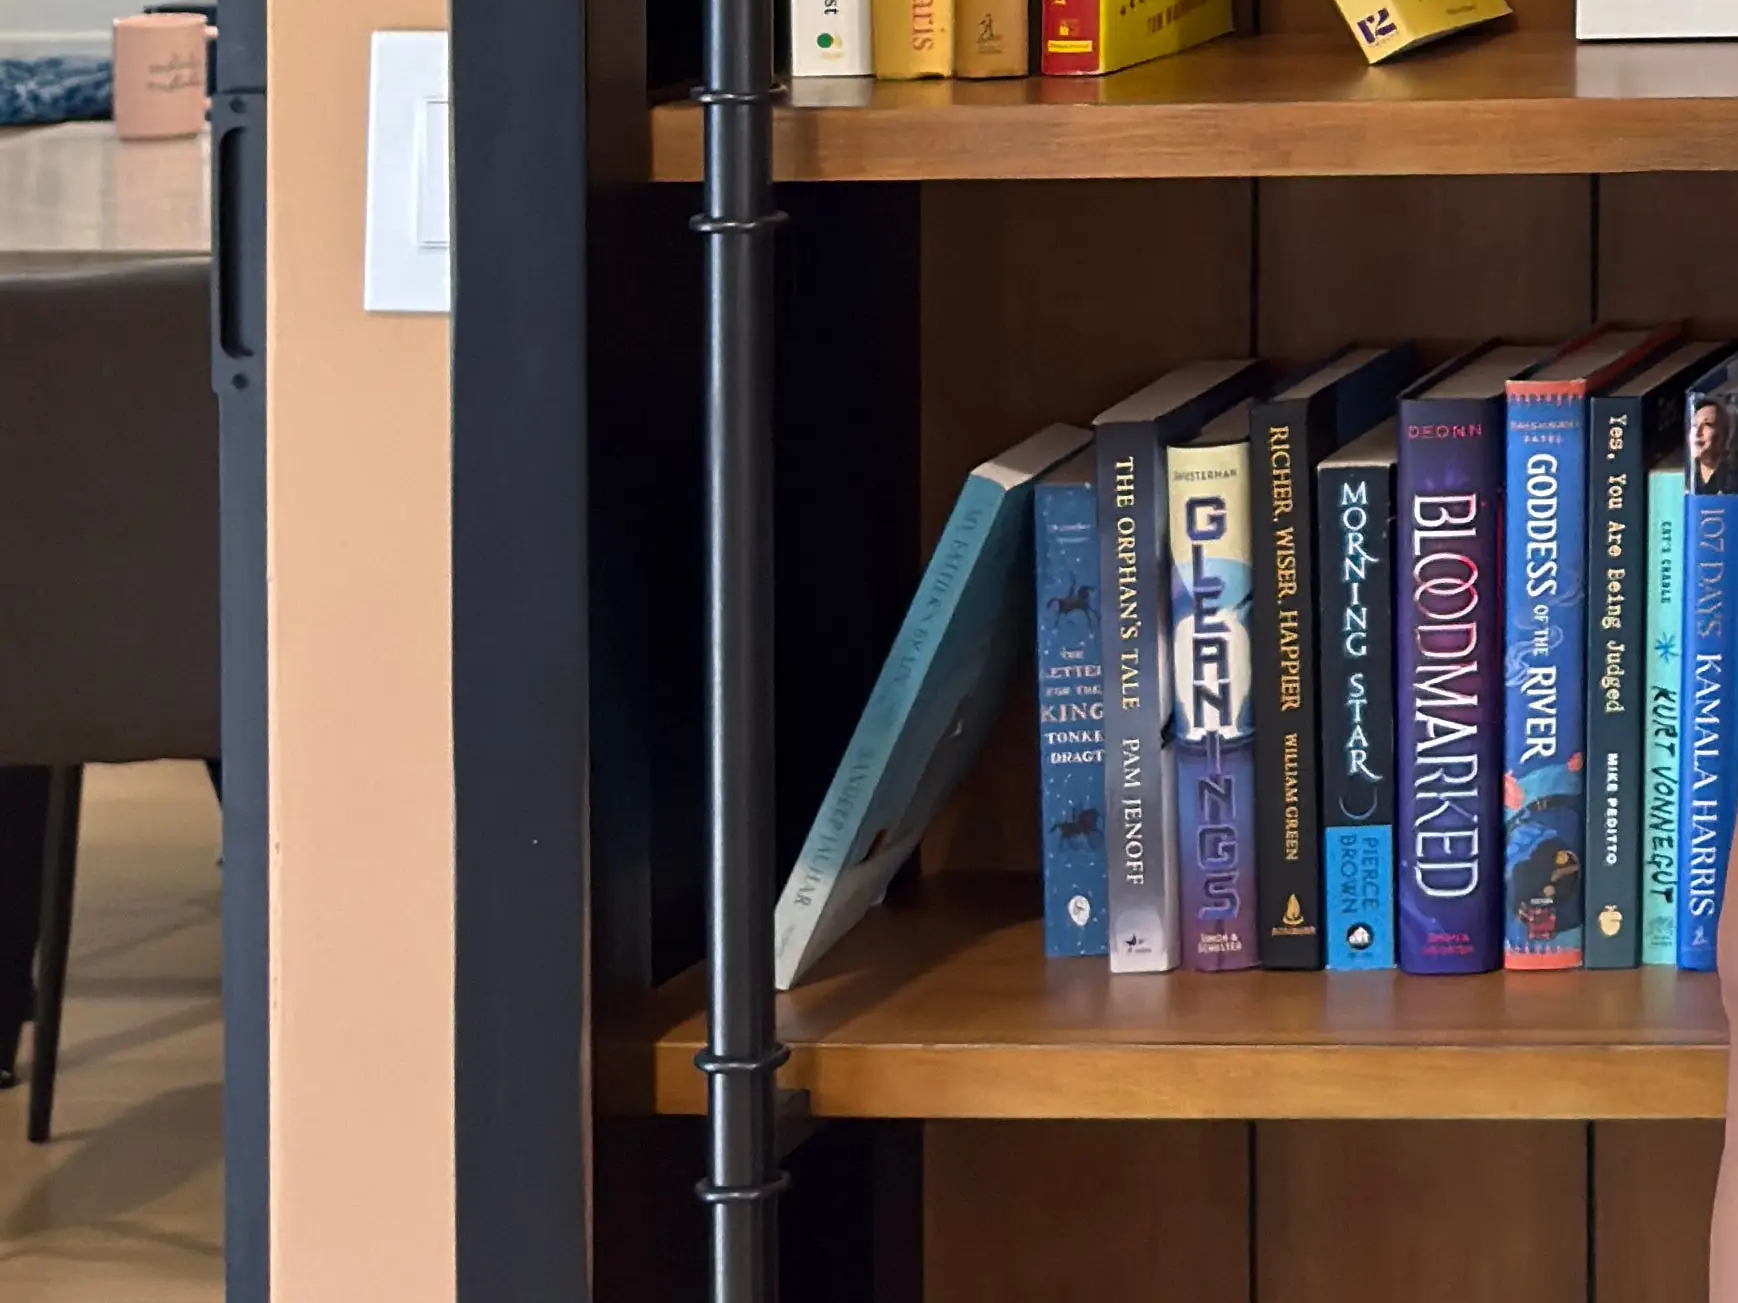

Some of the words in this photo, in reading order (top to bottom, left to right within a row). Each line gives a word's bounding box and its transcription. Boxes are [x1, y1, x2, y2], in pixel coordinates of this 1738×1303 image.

[1408, 424, 1482, 440] DEONN
[1114, 456, 1135, 508] THE
[1526, 453, 1558, 598] GODDESS
[1700, 508, 1726, 554] 107
[1116, 516, 1142, 640] ORPHAN'S
[1339, 480, 1380, 657] MORNING
[1696, 562, 1725, 639] DAYS
[1532, 604, 1549, 624] OF
[1532, 624, 1549, 657] THE
[1120, 648, 1140, 710] TALE
[1186, 496, 1240, 920] GLEANINGS
[1412, 493, 1479, 898] BLOODMARKED
[1520, 666, 1558, 764] RIVER
[1121, 738, 1140, 788] PAM
[1346, 672, 1384, 780] STAR
[1692, 653, 1723, 791] KAMALA
[1120, 798, 1144, 885] JENOFF
[1340, 835, 1358, 914] BROWN
[1362, 837, 1380, 912] PIERCE
[1688, 798, 1718, 917] HARRIS
